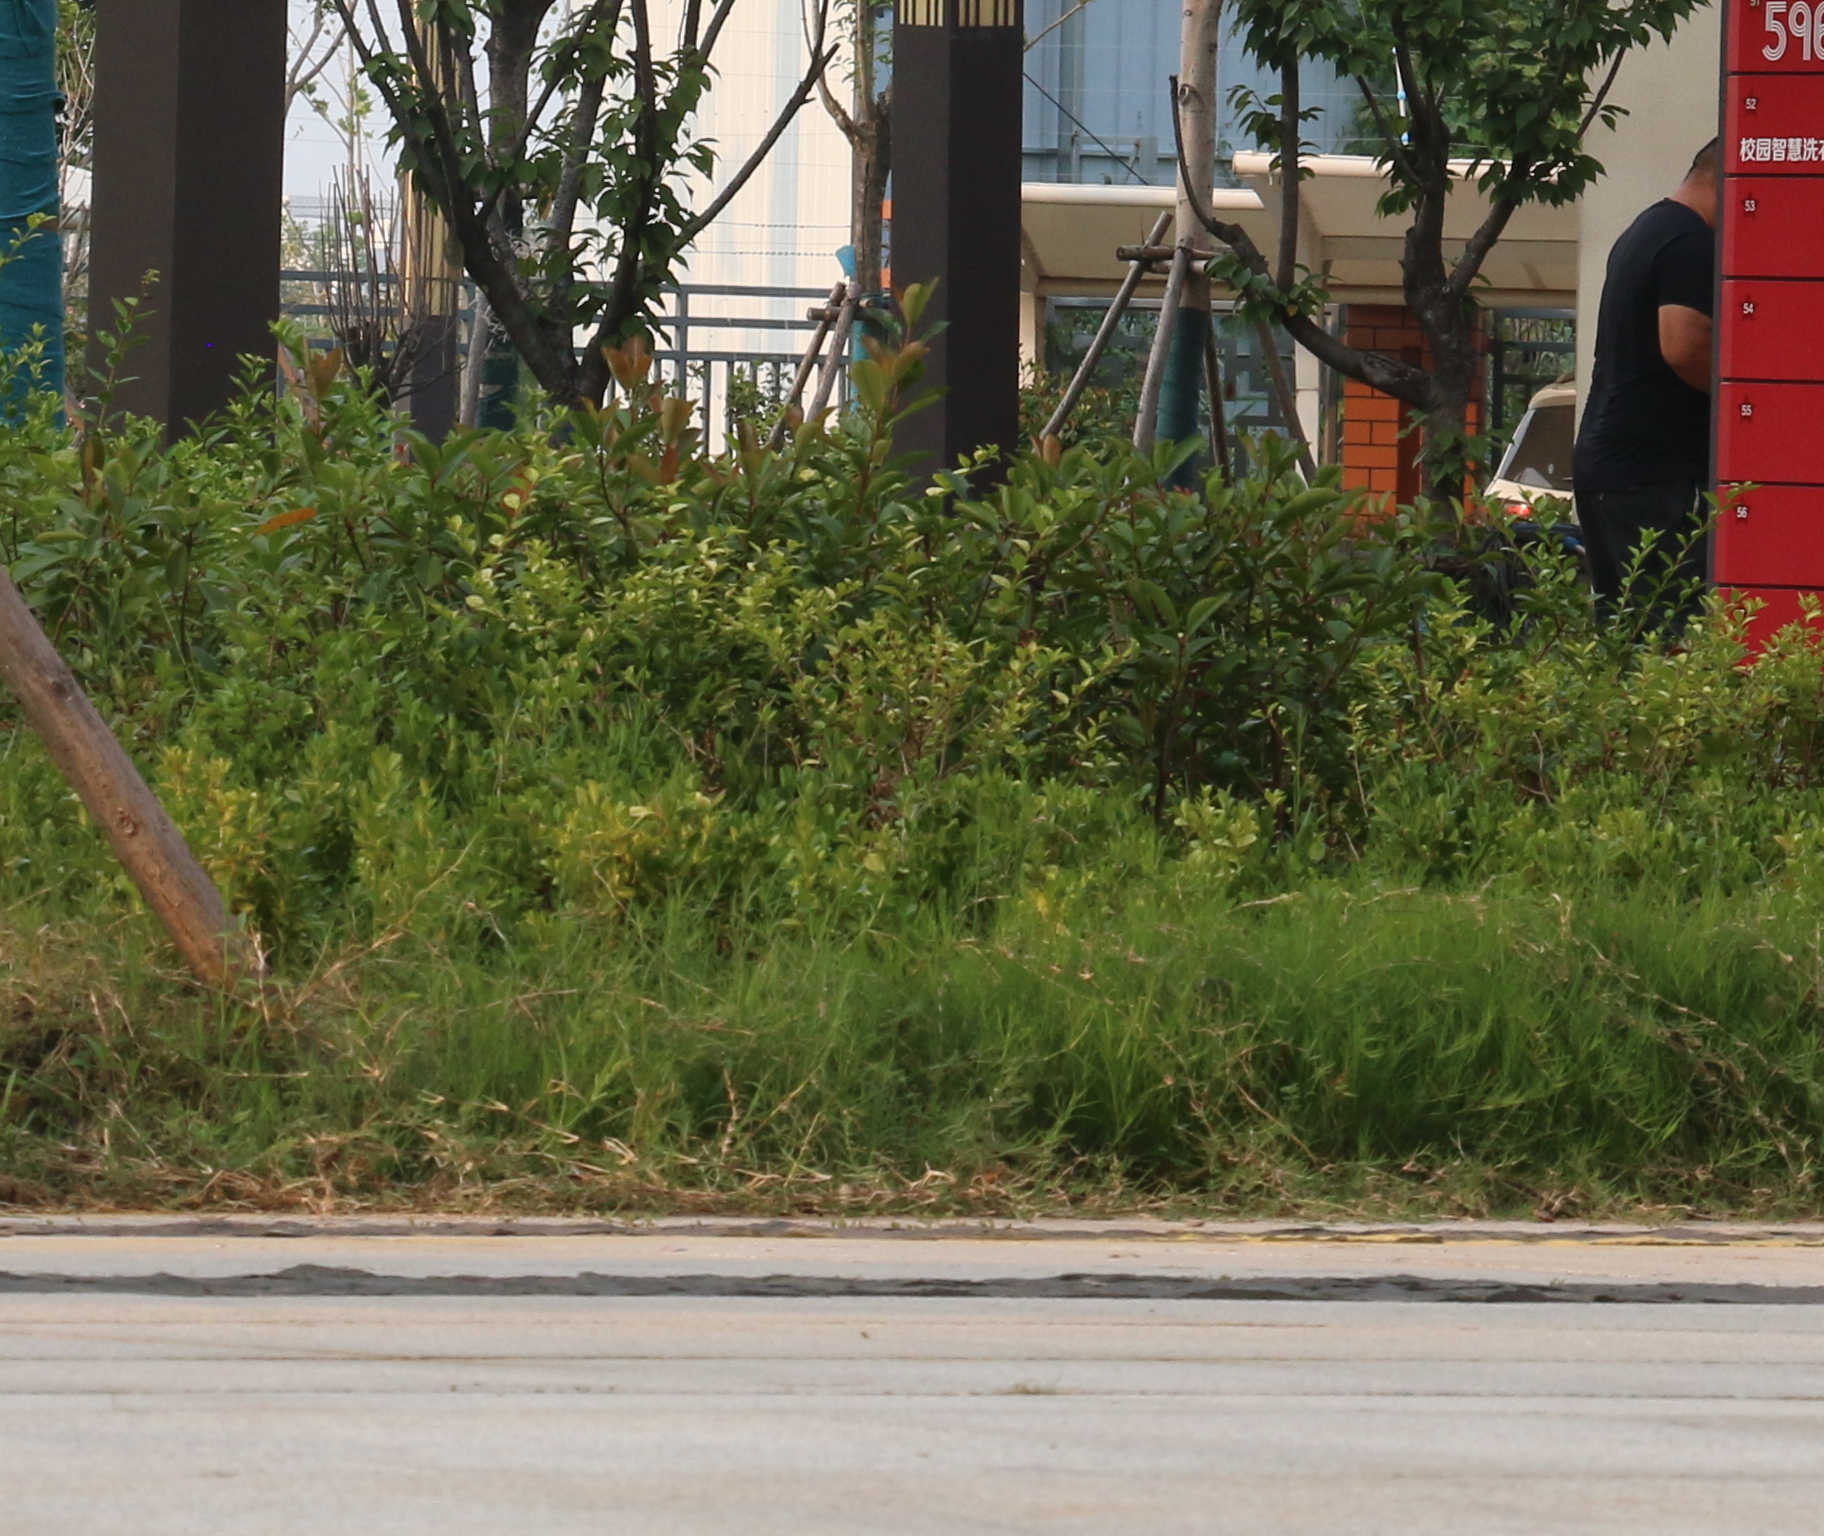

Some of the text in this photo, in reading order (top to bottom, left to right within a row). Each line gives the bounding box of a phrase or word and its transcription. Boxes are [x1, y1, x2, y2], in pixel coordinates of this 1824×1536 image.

[1745, 97, 1757, 110] 52
[1744, 199, 1756, 212] 53
[1742, 302, 1754, 315] 54
[1740, 404, 1753, 417] 55
[1736, 506, 1748, 519] 56
